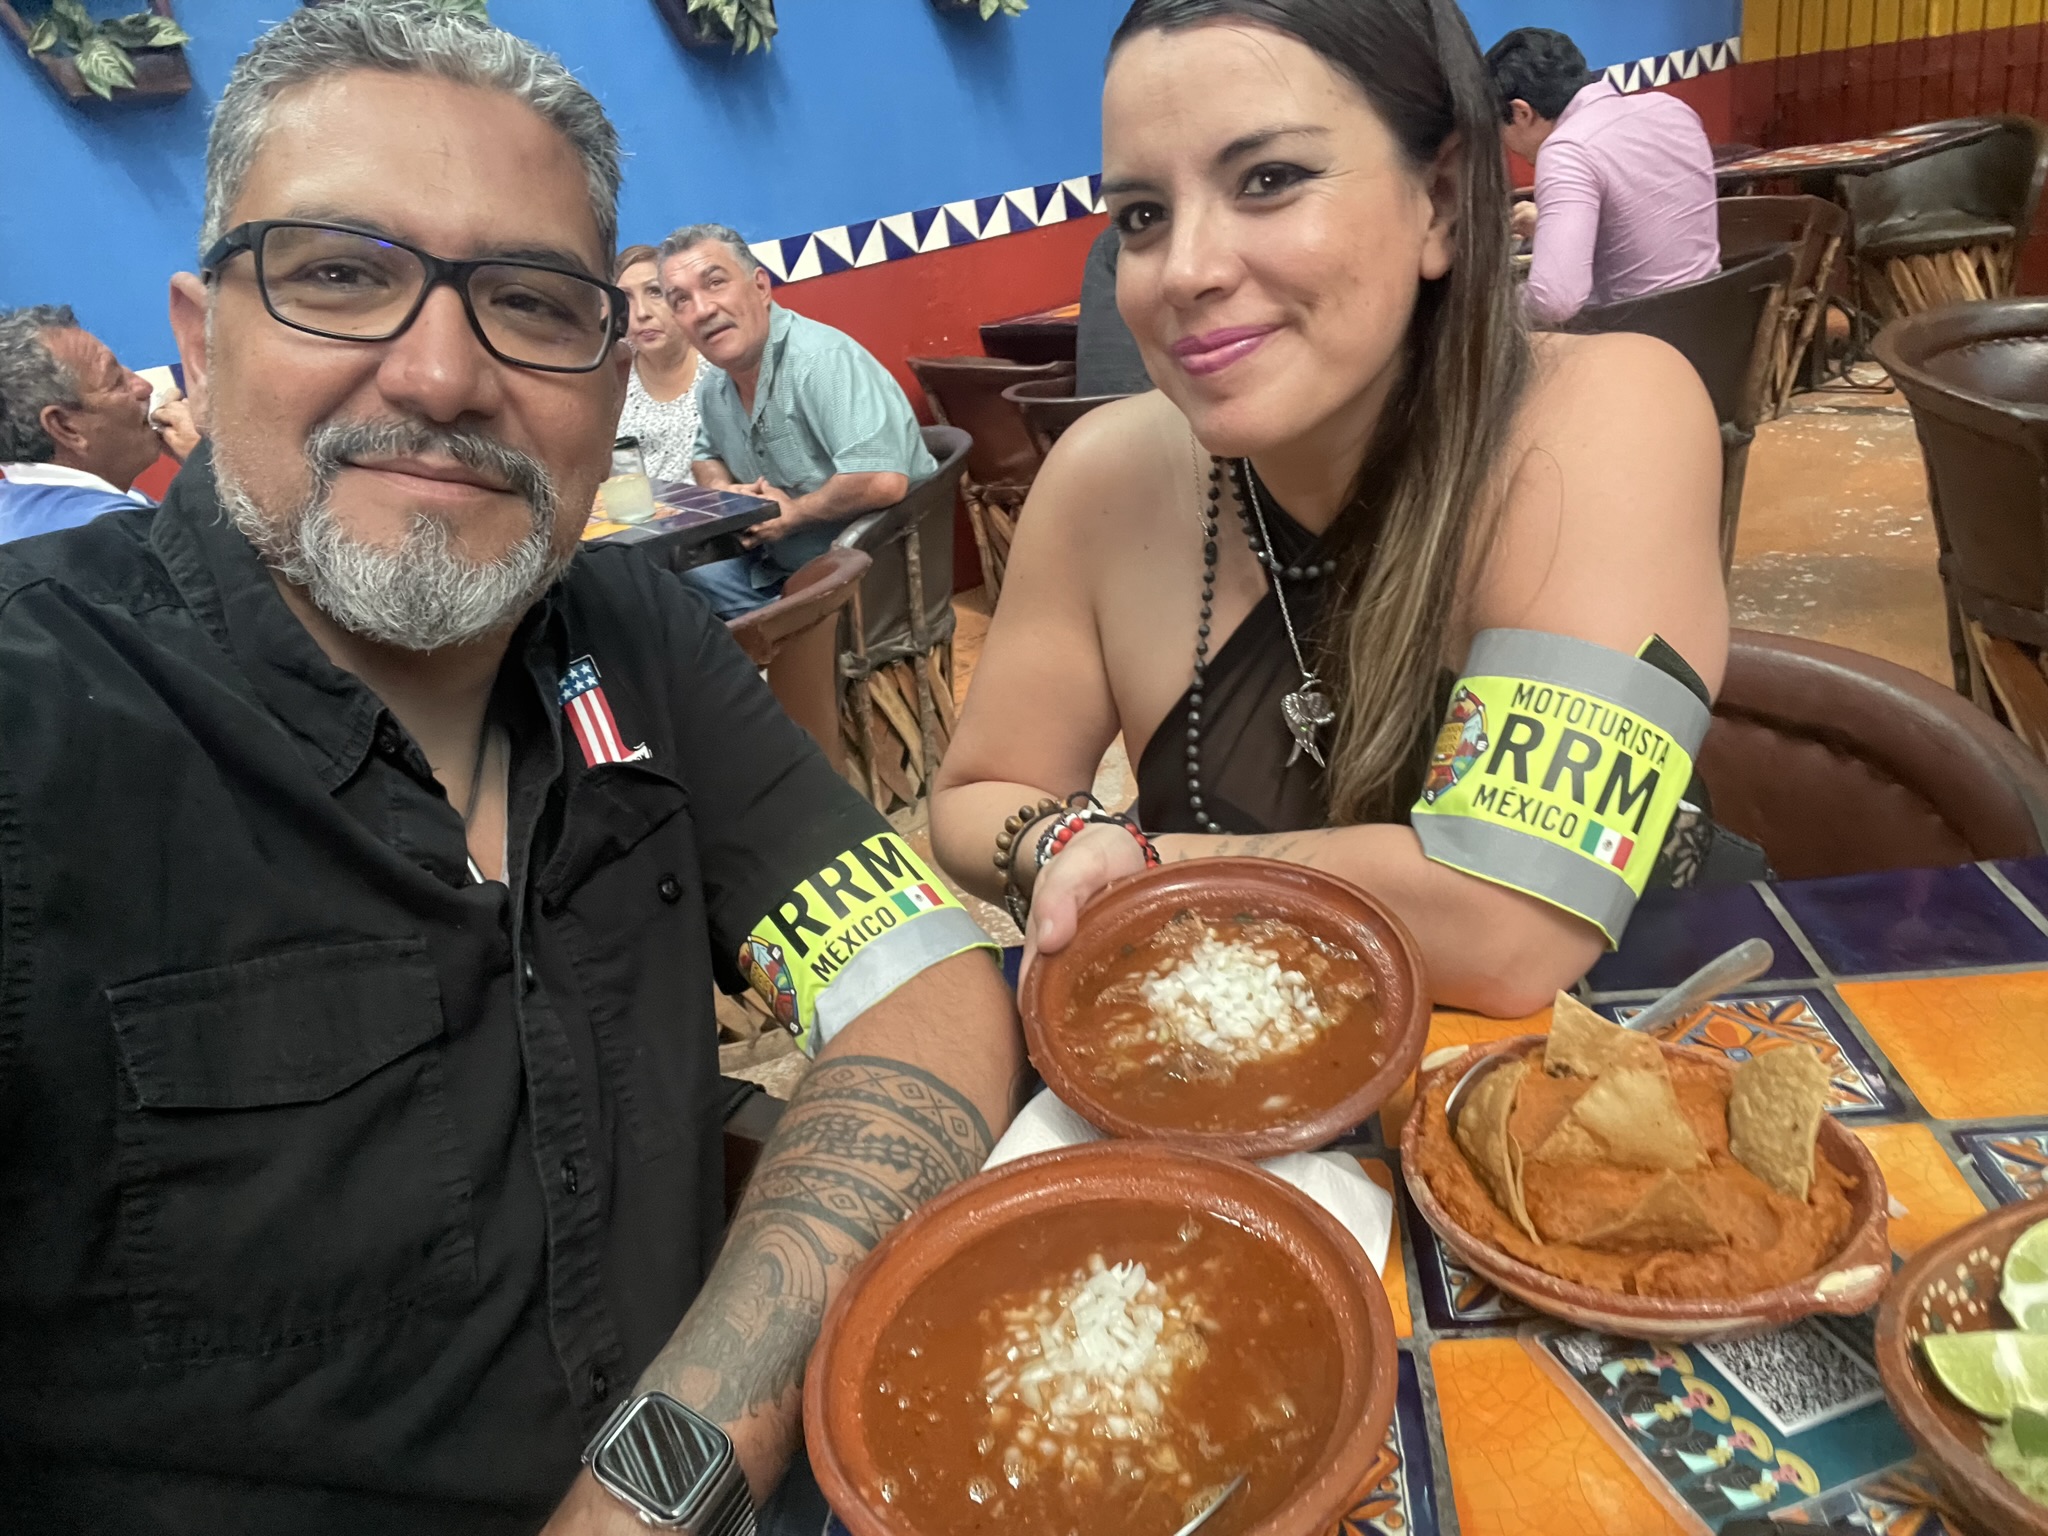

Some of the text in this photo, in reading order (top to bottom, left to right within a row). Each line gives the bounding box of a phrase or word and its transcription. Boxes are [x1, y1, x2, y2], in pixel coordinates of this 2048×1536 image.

[1511, 682, 1671, 770] MOTOTURISTA
[1472, 783, 1578, 839] MÉXICO
[1485, 712, 1661, 836] RRM
[767, 836, 925, 959] RRM
[810, 906, 897, 982] MÉXICO
